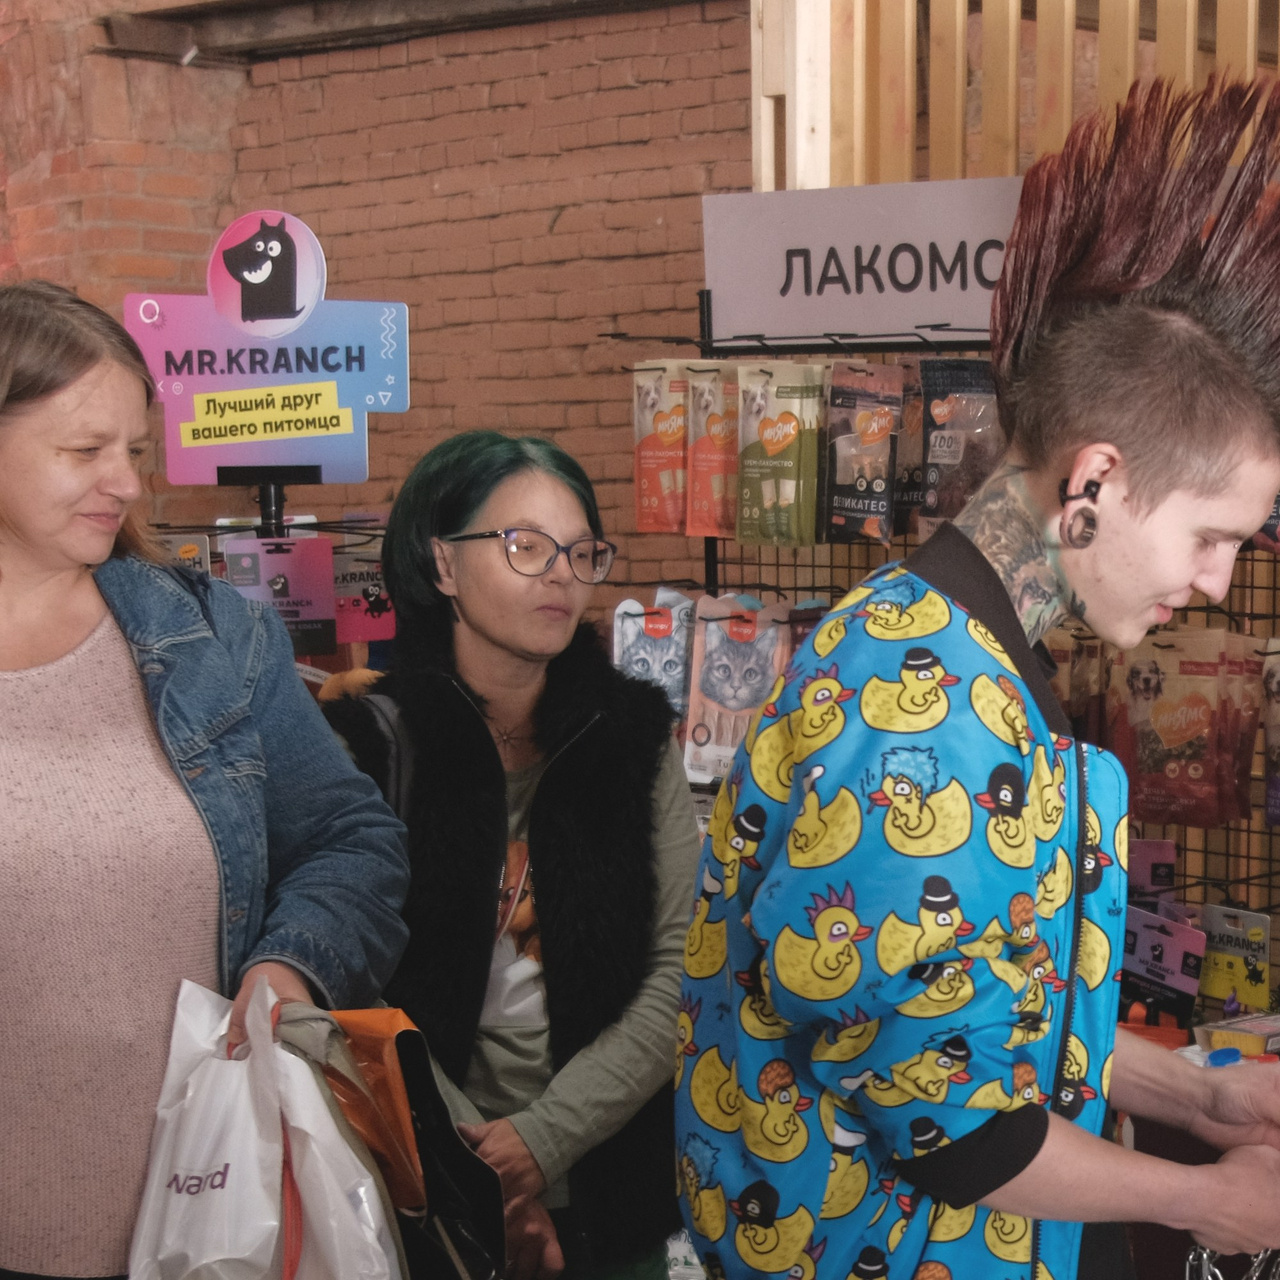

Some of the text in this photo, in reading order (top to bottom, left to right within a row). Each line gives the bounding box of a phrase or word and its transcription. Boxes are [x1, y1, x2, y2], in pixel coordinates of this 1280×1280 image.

[164, 345, 366, 376] MR.KRANCH
[205, 391, 323, 418] Лучший друг
[192, 414, 341, 440] вашего питомца
